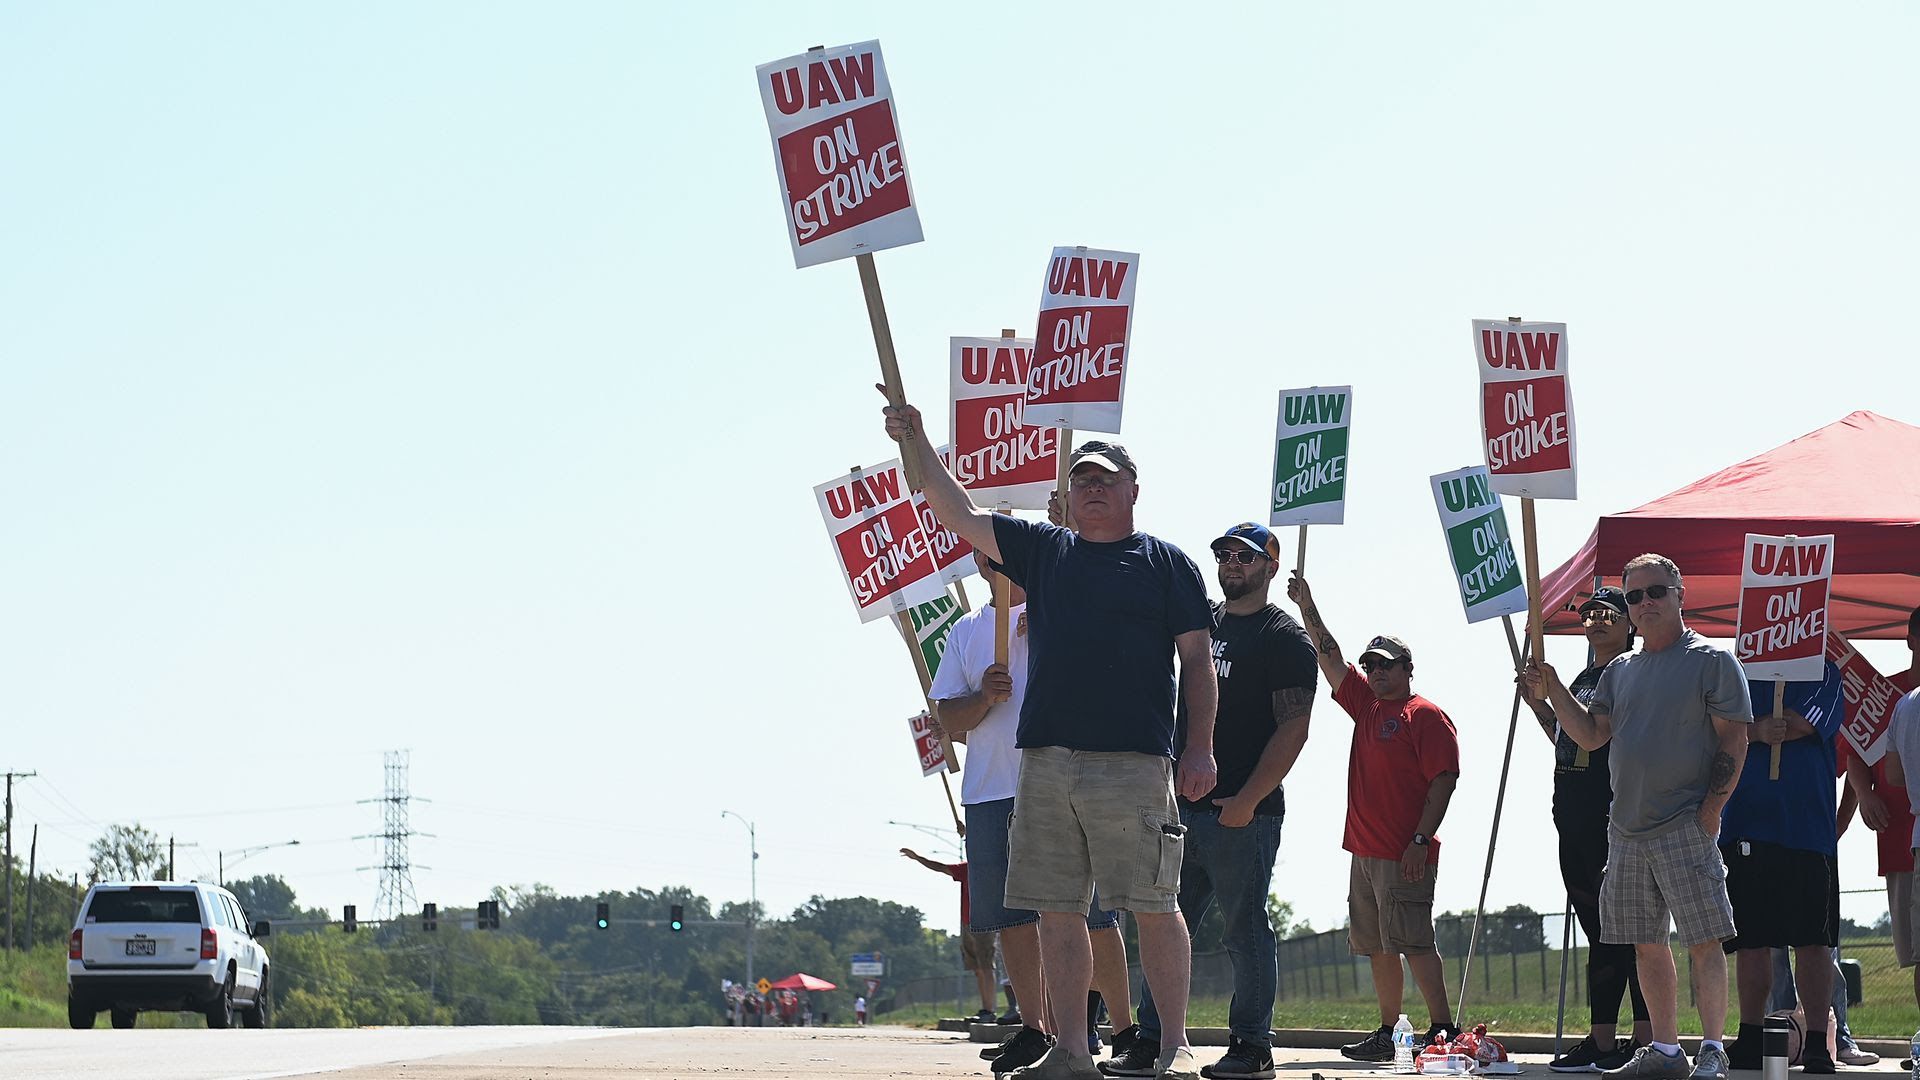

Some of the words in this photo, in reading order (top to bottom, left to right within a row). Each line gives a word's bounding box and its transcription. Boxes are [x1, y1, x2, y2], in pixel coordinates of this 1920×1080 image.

[770, 52, 875, 115] UAW
[813, 117, 859, 175] ON
[793, 141, 903, 240] STRIKE
[1048, 256, 1128, 300] UAW
[1053, 311, 1091, 353] ON
[1481, 329, 1560, 371] UAW
[1027, 343, 1124, 401] STRIKE
[984, 398, 1023, 440] ON
[1284, 393, 1346, 426] UAW
[1504, 384, 1534, 426] ON
[957, 427, 1056, 486] STRIKE
[1295, 434, 1322, 469] ON
[1488, 411, 1568, 471] STRIKE
[825, 467, 901, 520] UAW
[1274, 455, 1345, 509] STRIKE
[860, 516, 893, 559] ON
[1472, 516, 1499, 557] ON
[1751, 542, 1828, 577] UAW
[853, 527, 927, 605] STRIKE
[1462, 537, 1516, 604] STRIKE
[1766, 587, 1802, 622] ON
[1738, 608, 1824, 660] STRIKE
[1842, 666, 1866, 704] ON
[1848, 673, 1894, 748] STRIKE
